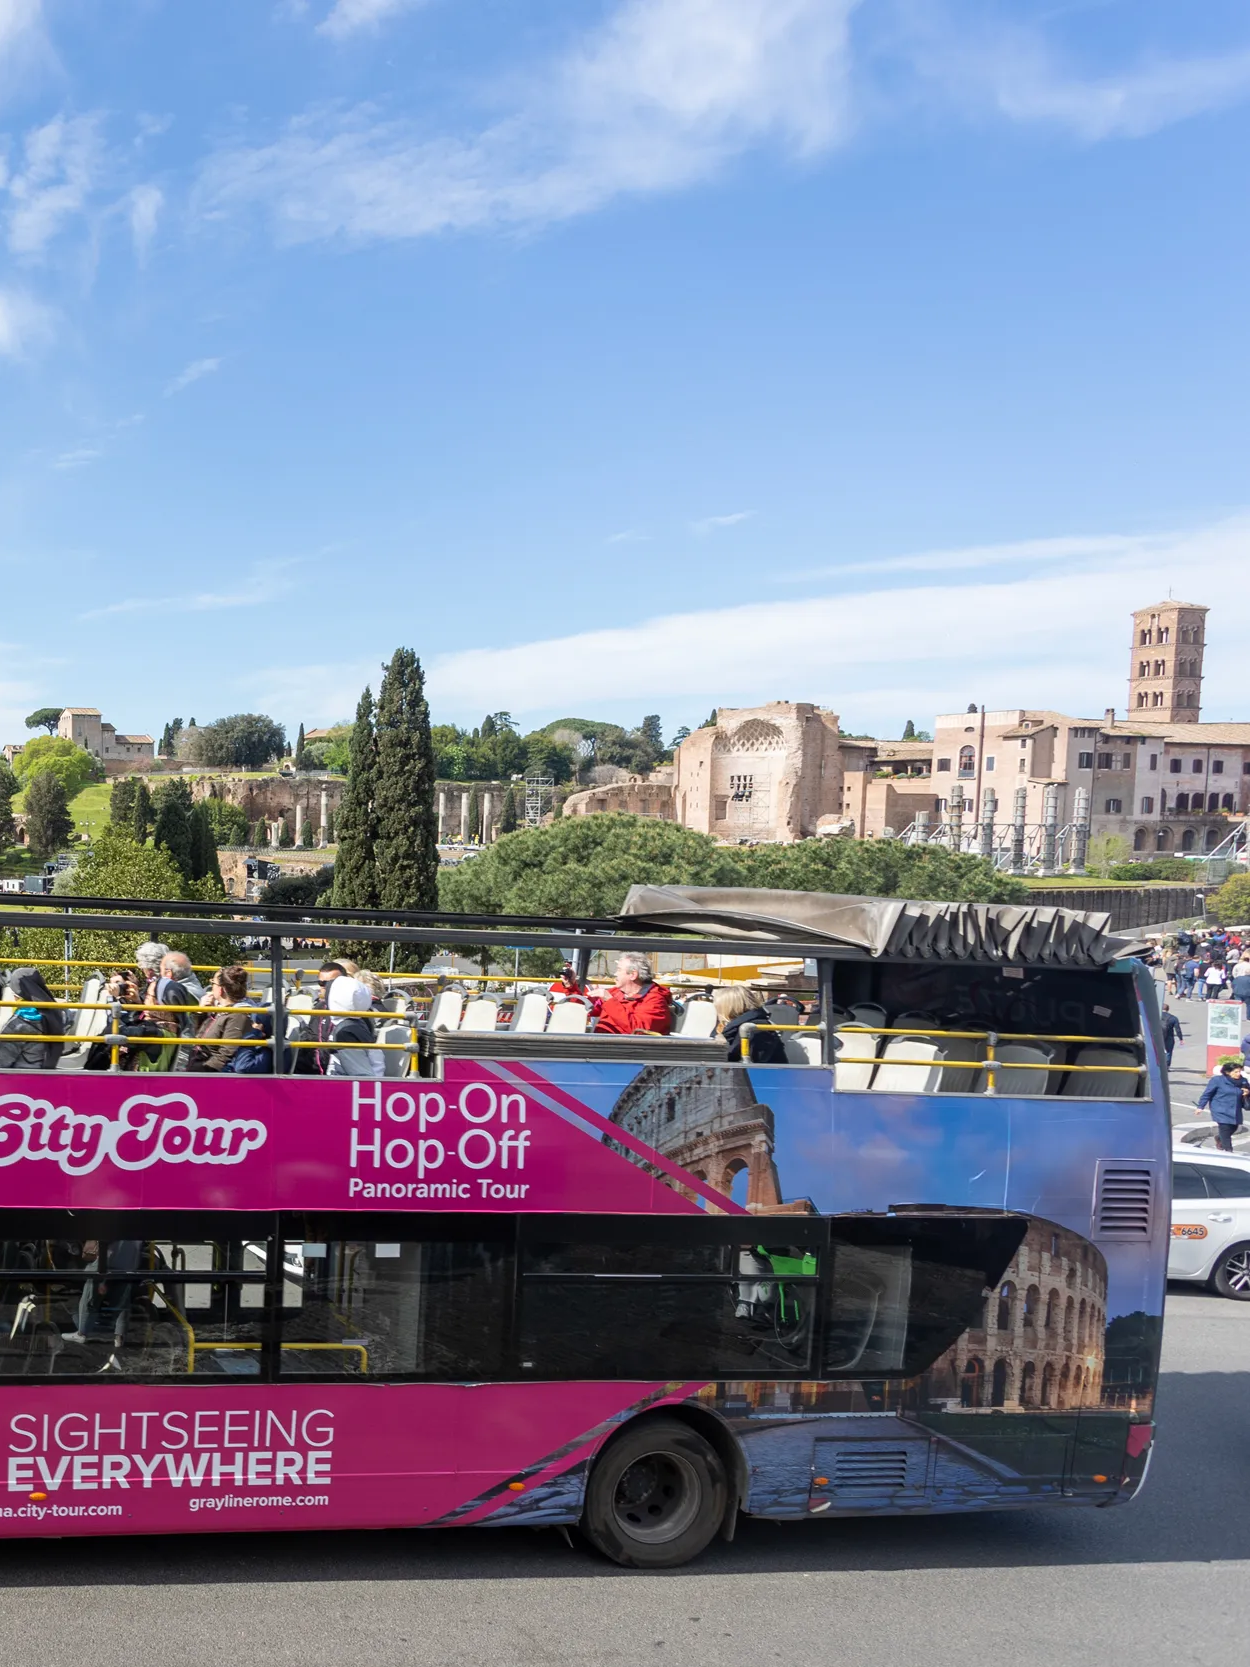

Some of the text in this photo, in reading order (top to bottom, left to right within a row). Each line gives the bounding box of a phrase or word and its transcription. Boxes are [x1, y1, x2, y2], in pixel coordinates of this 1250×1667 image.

[351, 1081, 527, 1133] Hop-On
[112, 1094, 264, 1170] Tour
[349, 1127, 532, 1179] Hop-Off
[348, 1177, 530, 1199] Panoramic Tour
[1181, 1227, 1204, 1236] 6645
[8, 1410, 335, 1453] SIGHTSEEING
[7, 1450, 333, 1492] EVERYWHERE
[188, 1493, 330, 1512] graylinerome.com
